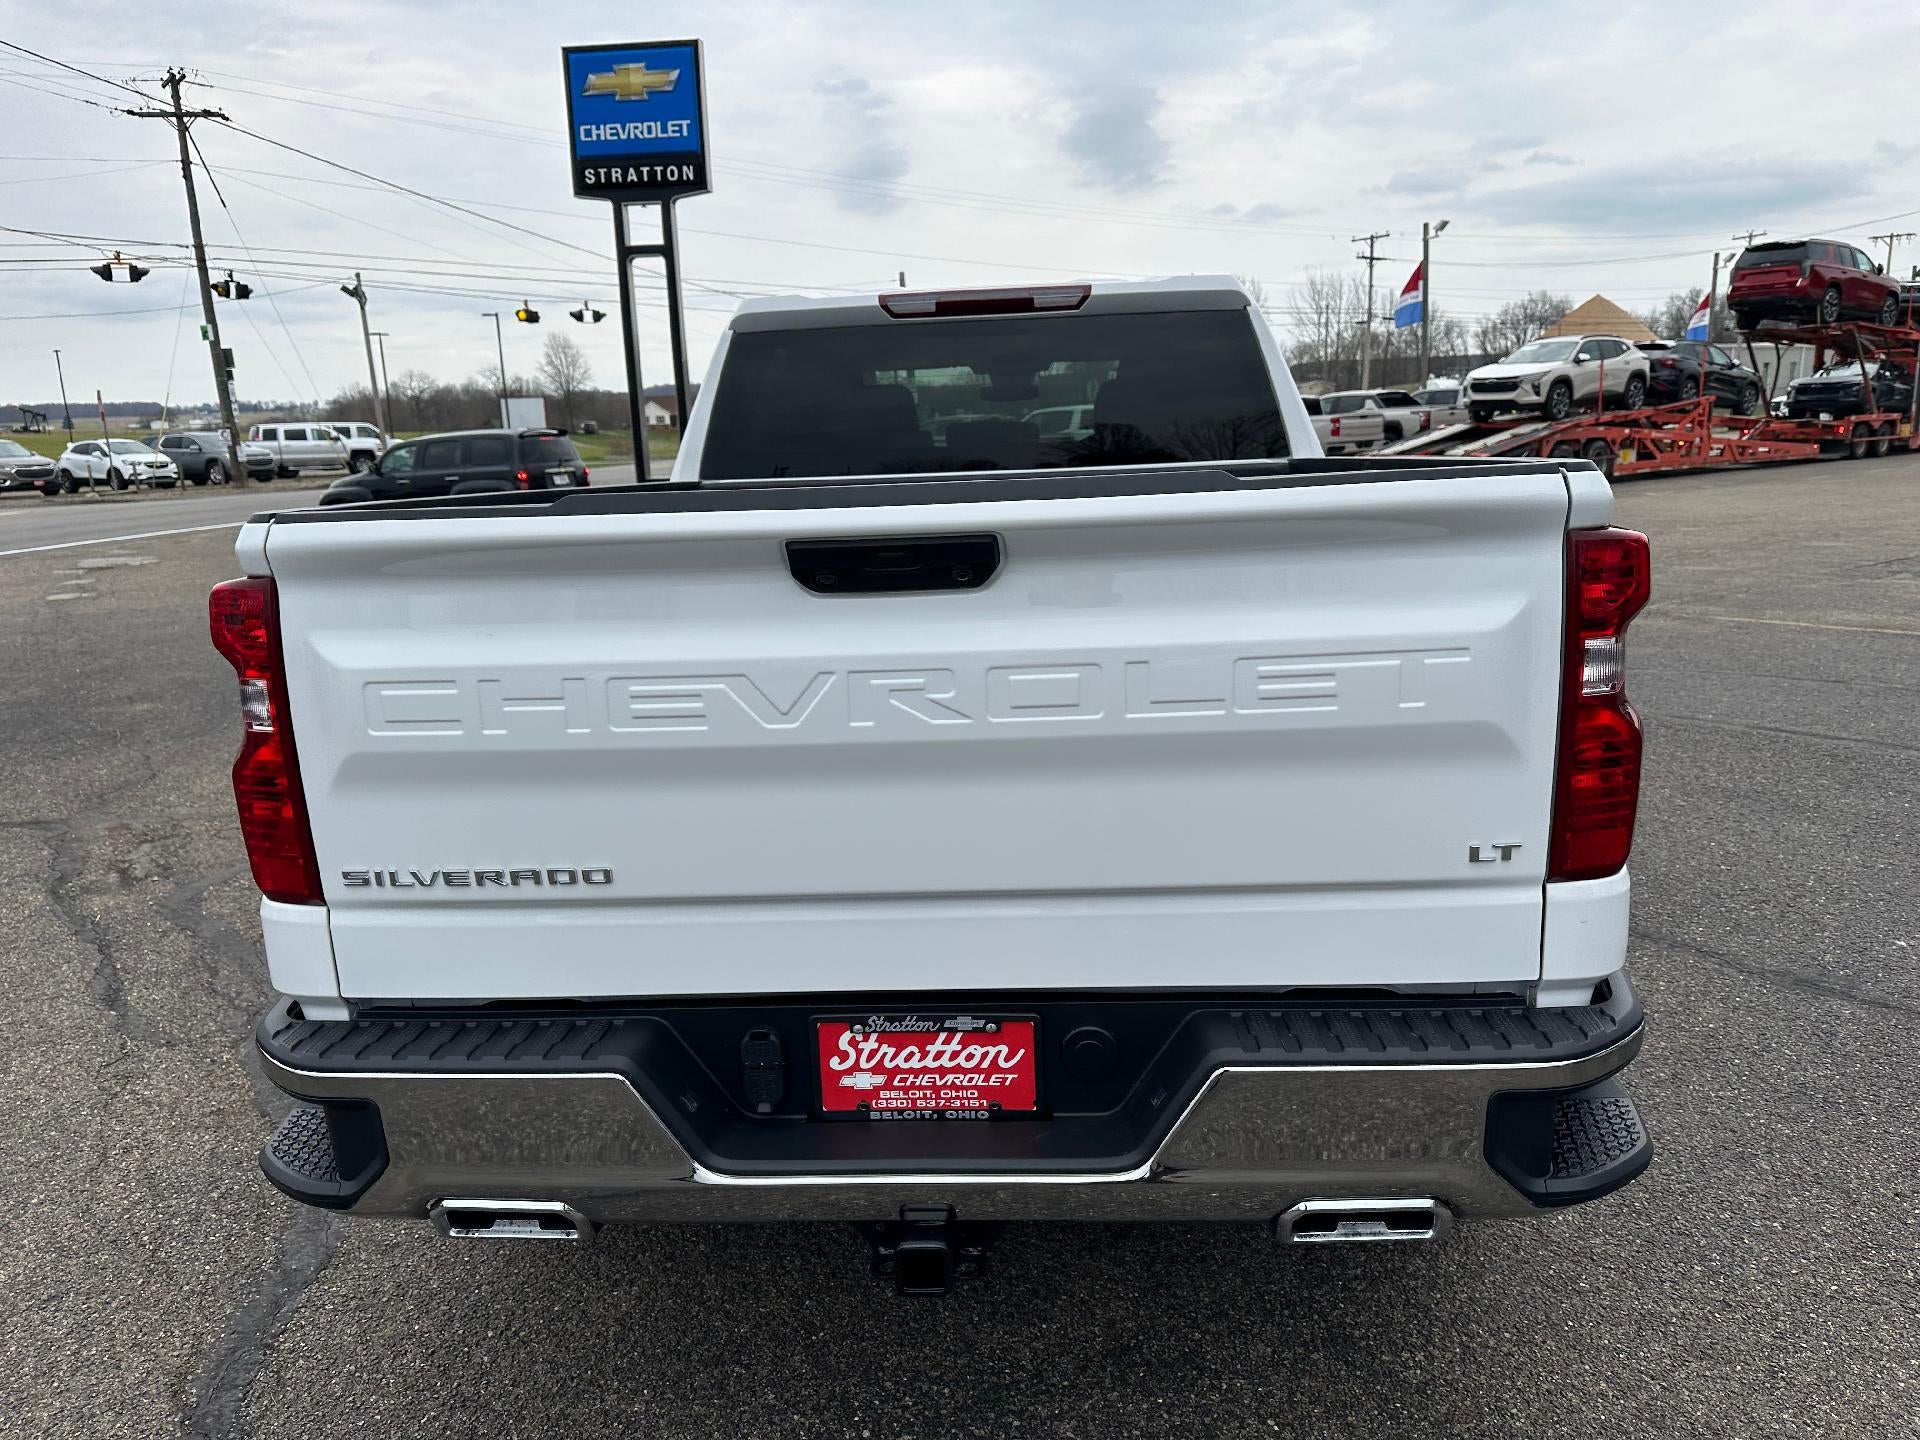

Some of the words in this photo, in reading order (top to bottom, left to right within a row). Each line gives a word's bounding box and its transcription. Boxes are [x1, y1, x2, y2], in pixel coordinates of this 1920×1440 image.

[579, 120, 691, 141] CHEVROLET
[584, 165, 695, 184] STRATTON
[362, 647, 1471, 735] CHEVROLET
[1469, 843, 1522, 862] LT
[341, 867, 614, 887] SILVERADO
[865, 1015, 941, 1032] Stratton
[829, 1031, 1025, 1070] Stratton
[893, 1073, 1018, 1086] CHEVROLET
[872, 1100, 912, 1108] (330)
[916, 1099, 987, 1108] 537-3151
[879, 1090, 936, 1099] BELOIT,
[940, 1090, 979, 1098] OHIO
[869, 1111, 938, 1120] BELOIT,
[945, 1110, 989, 1119] OHIO
